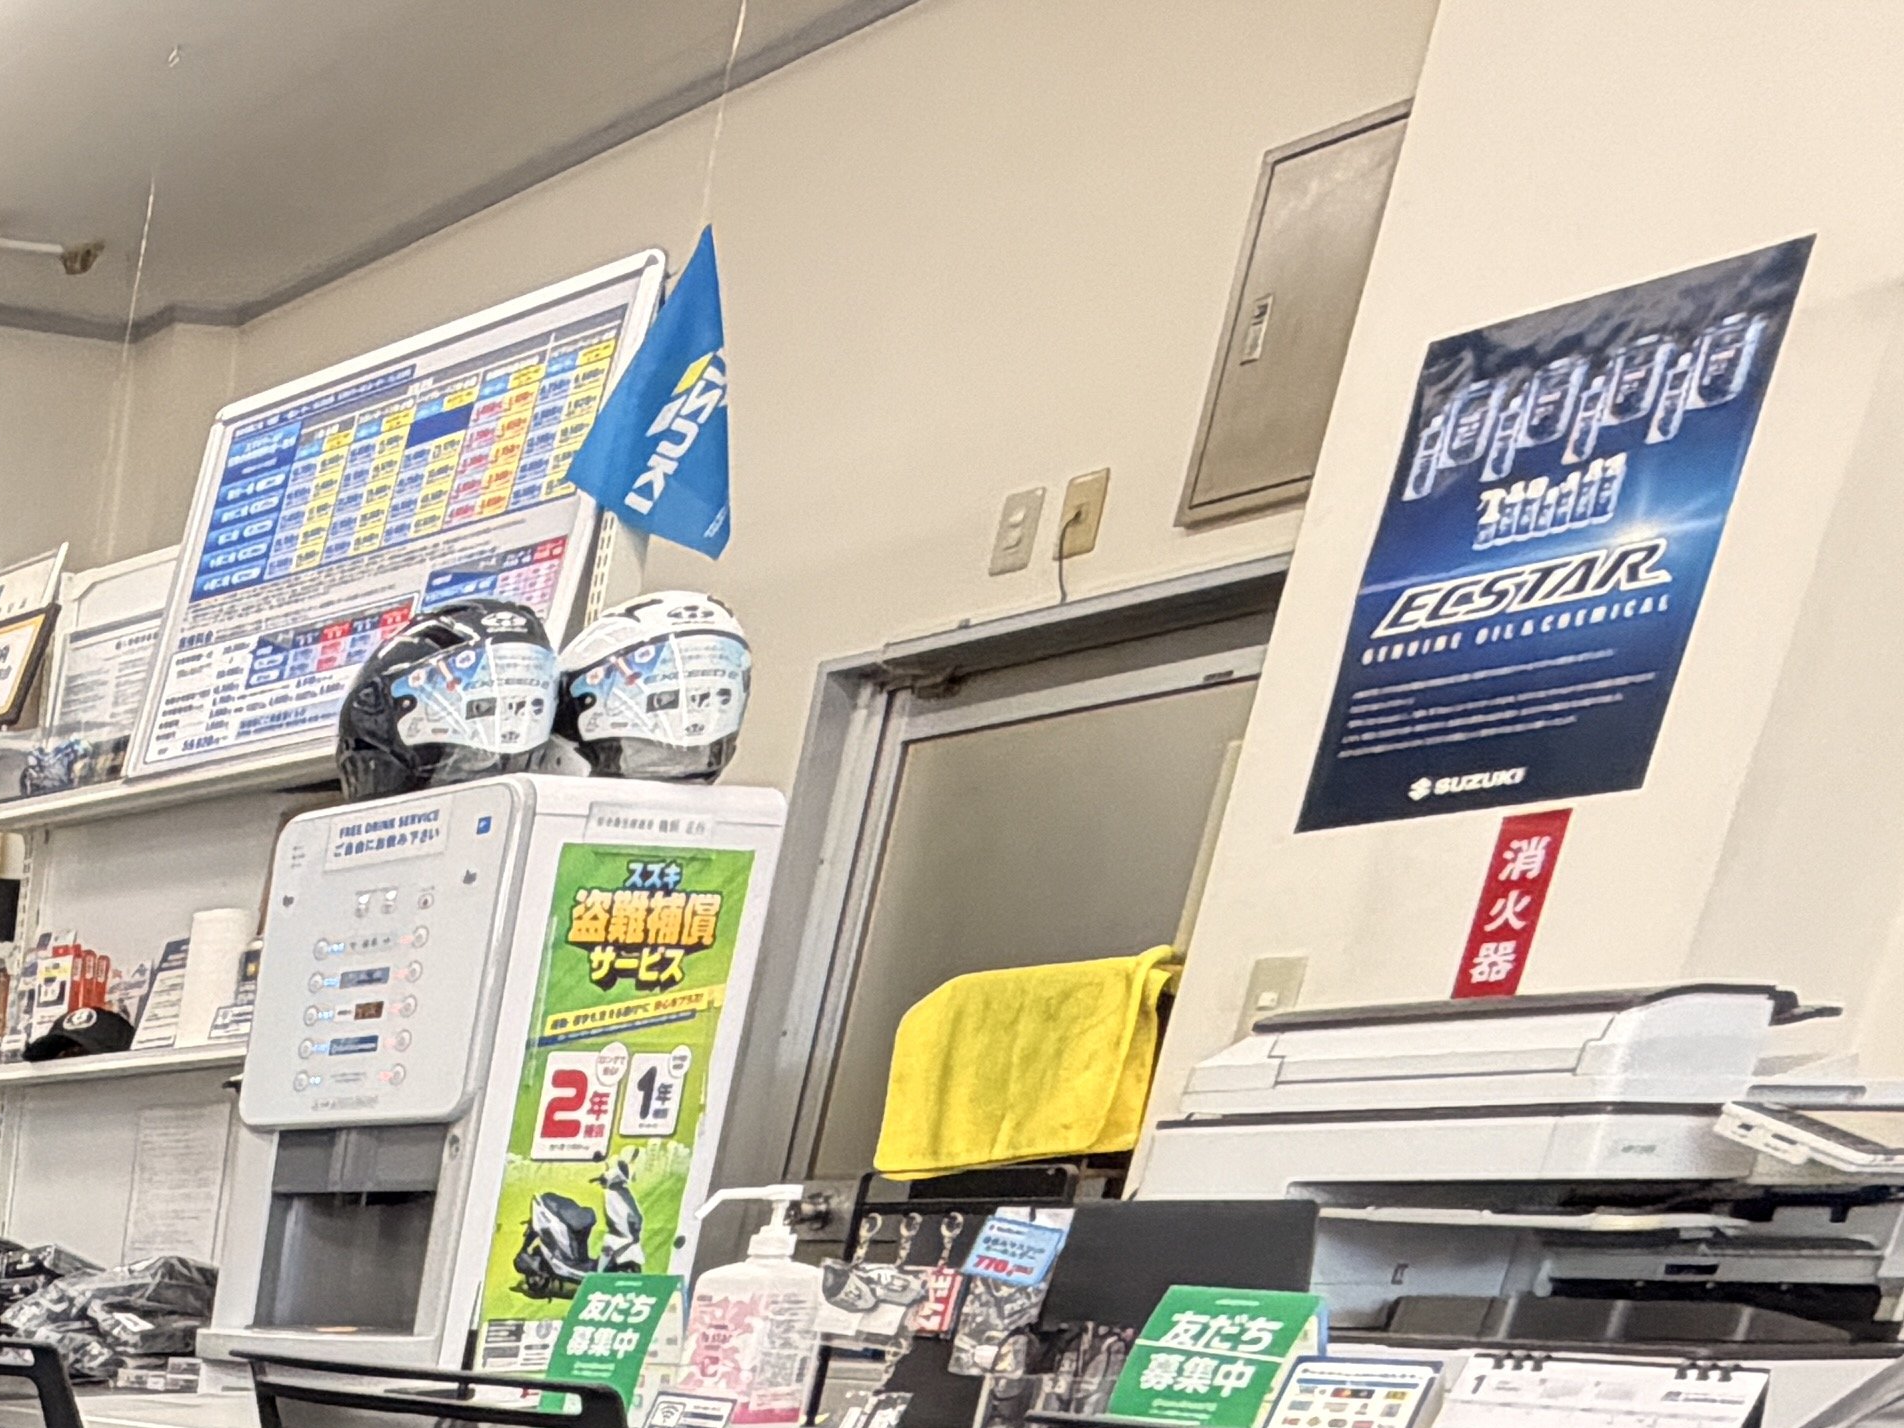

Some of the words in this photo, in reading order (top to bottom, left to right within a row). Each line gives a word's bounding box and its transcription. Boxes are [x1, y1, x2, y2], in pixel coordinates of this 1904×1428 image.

[1372, 537, 1671, 641] ECSTAR
[1433, 766, 1528, 795] SUZUKI
[398, 809, 440, 827] SERVICE
[625, 861, 681, 889] スズキ
[568, 888, 722, 946] 盗難補償
[1468, 833, 1554, 985] 消火器
[589, 946, 686, 982] サービス
[578, 1291, 657, 1324] 友だち
[566, 1325, 640, 1359] 募集中
[1160, 1311, 1284, 1353] 友だち
[1139, 1353, 1257, 1398] 募集中
